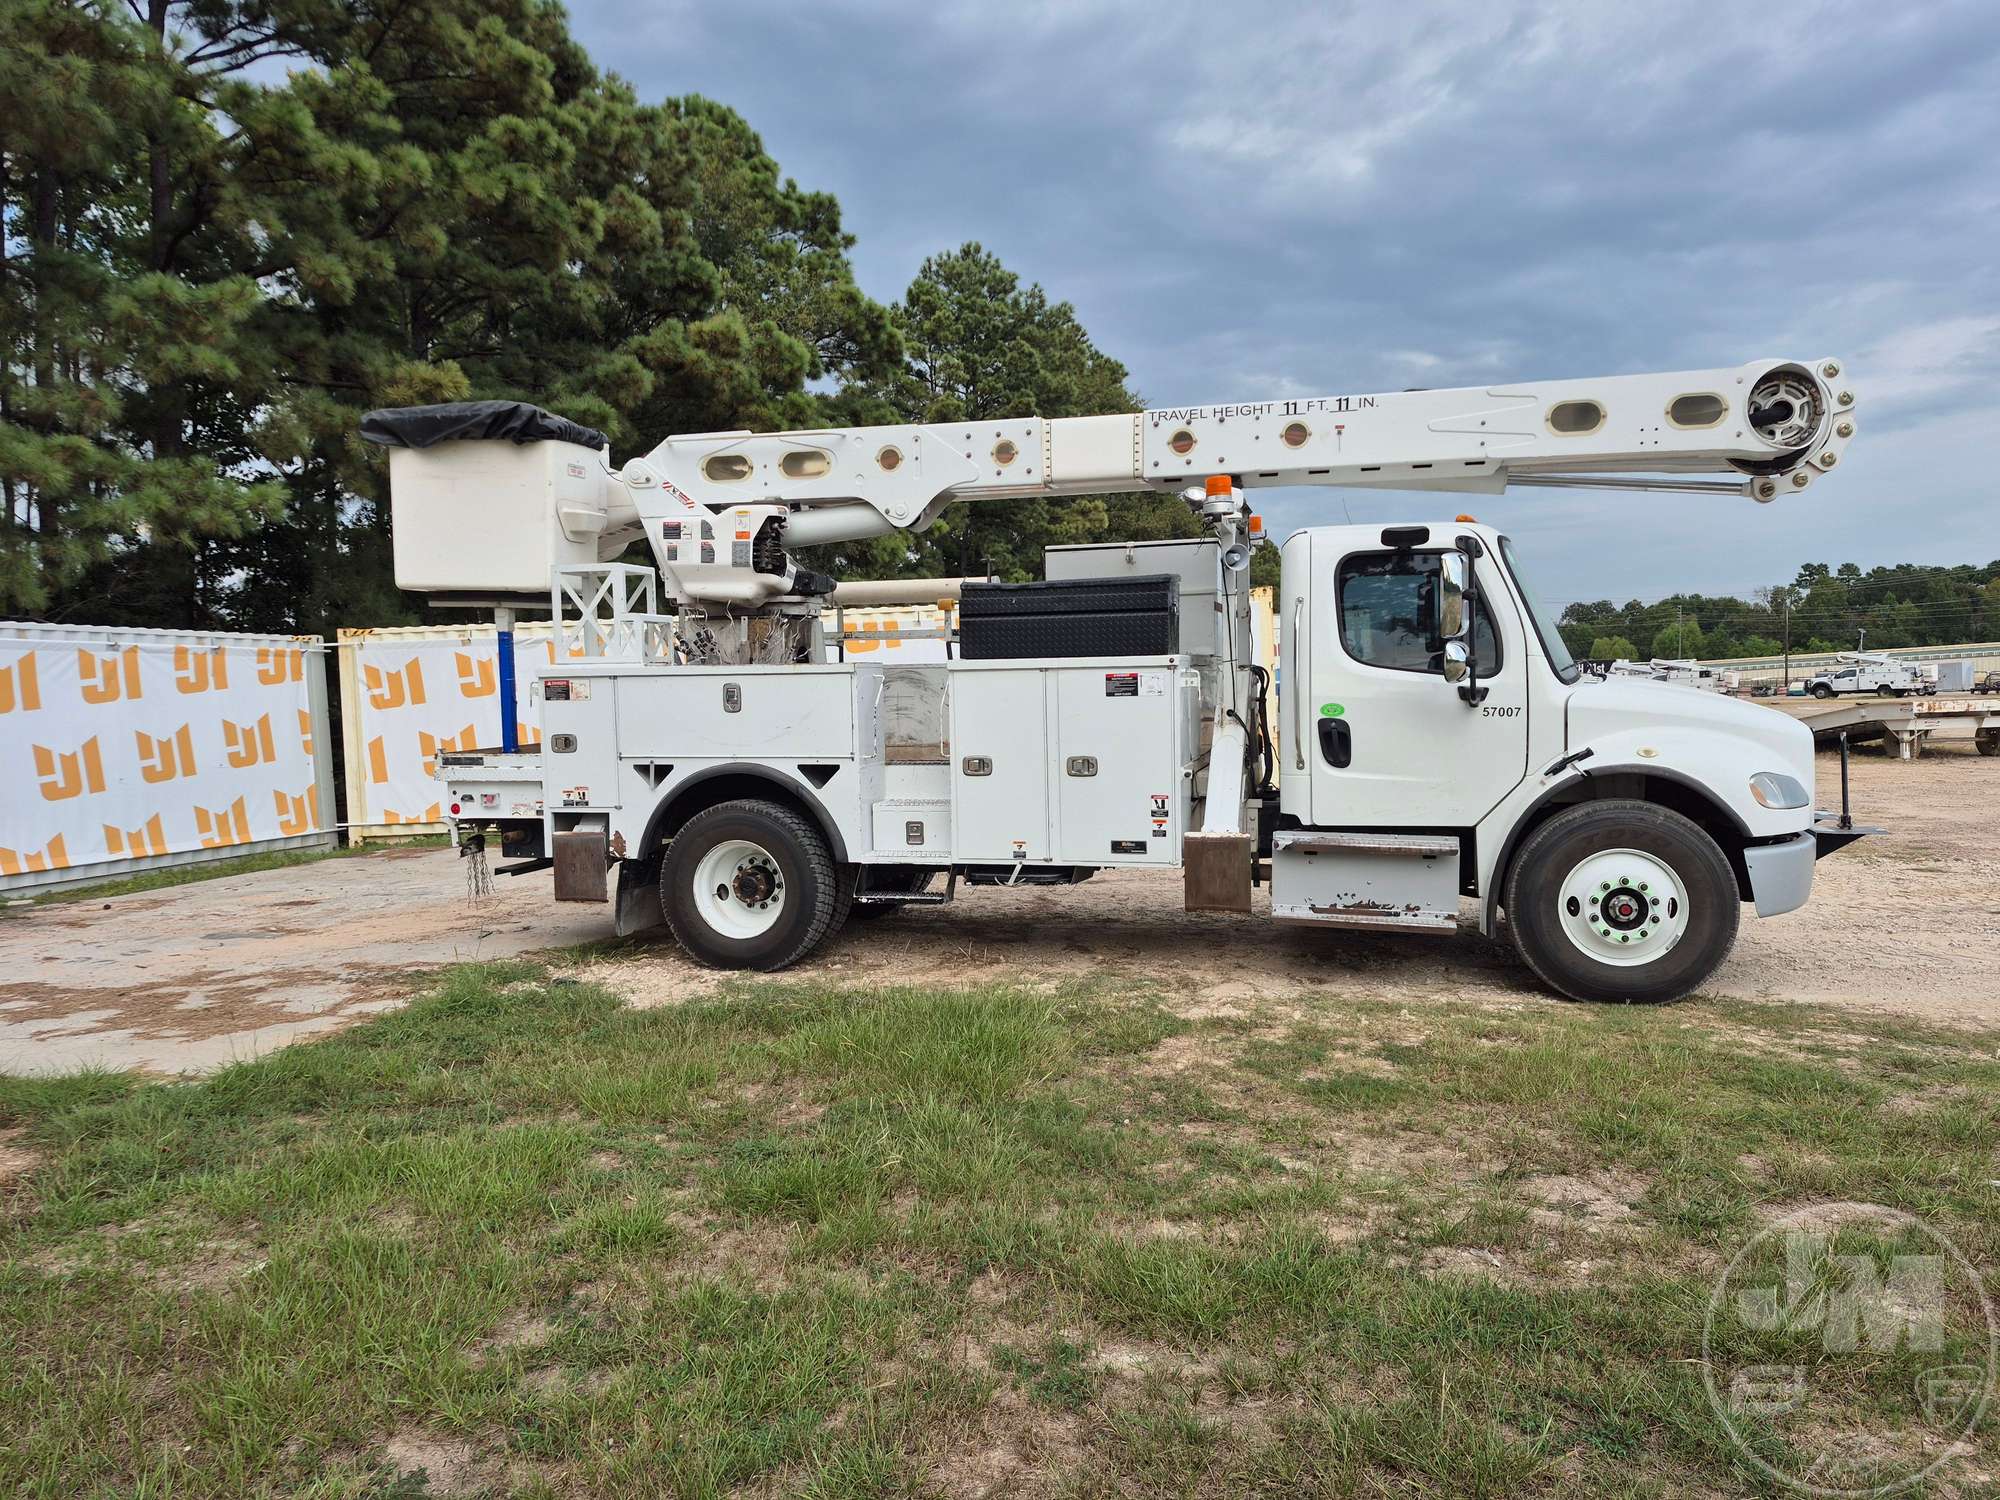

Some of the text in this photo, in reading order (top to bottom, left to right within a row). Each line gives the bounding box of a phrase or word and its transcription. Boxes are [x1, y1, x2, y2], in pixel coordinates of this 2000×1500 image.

[1150, 397, 1379, 422] TRAVEL HEIGHT 11 FT. 11 IN.
[1483, 706, 1521, 718] 57007
